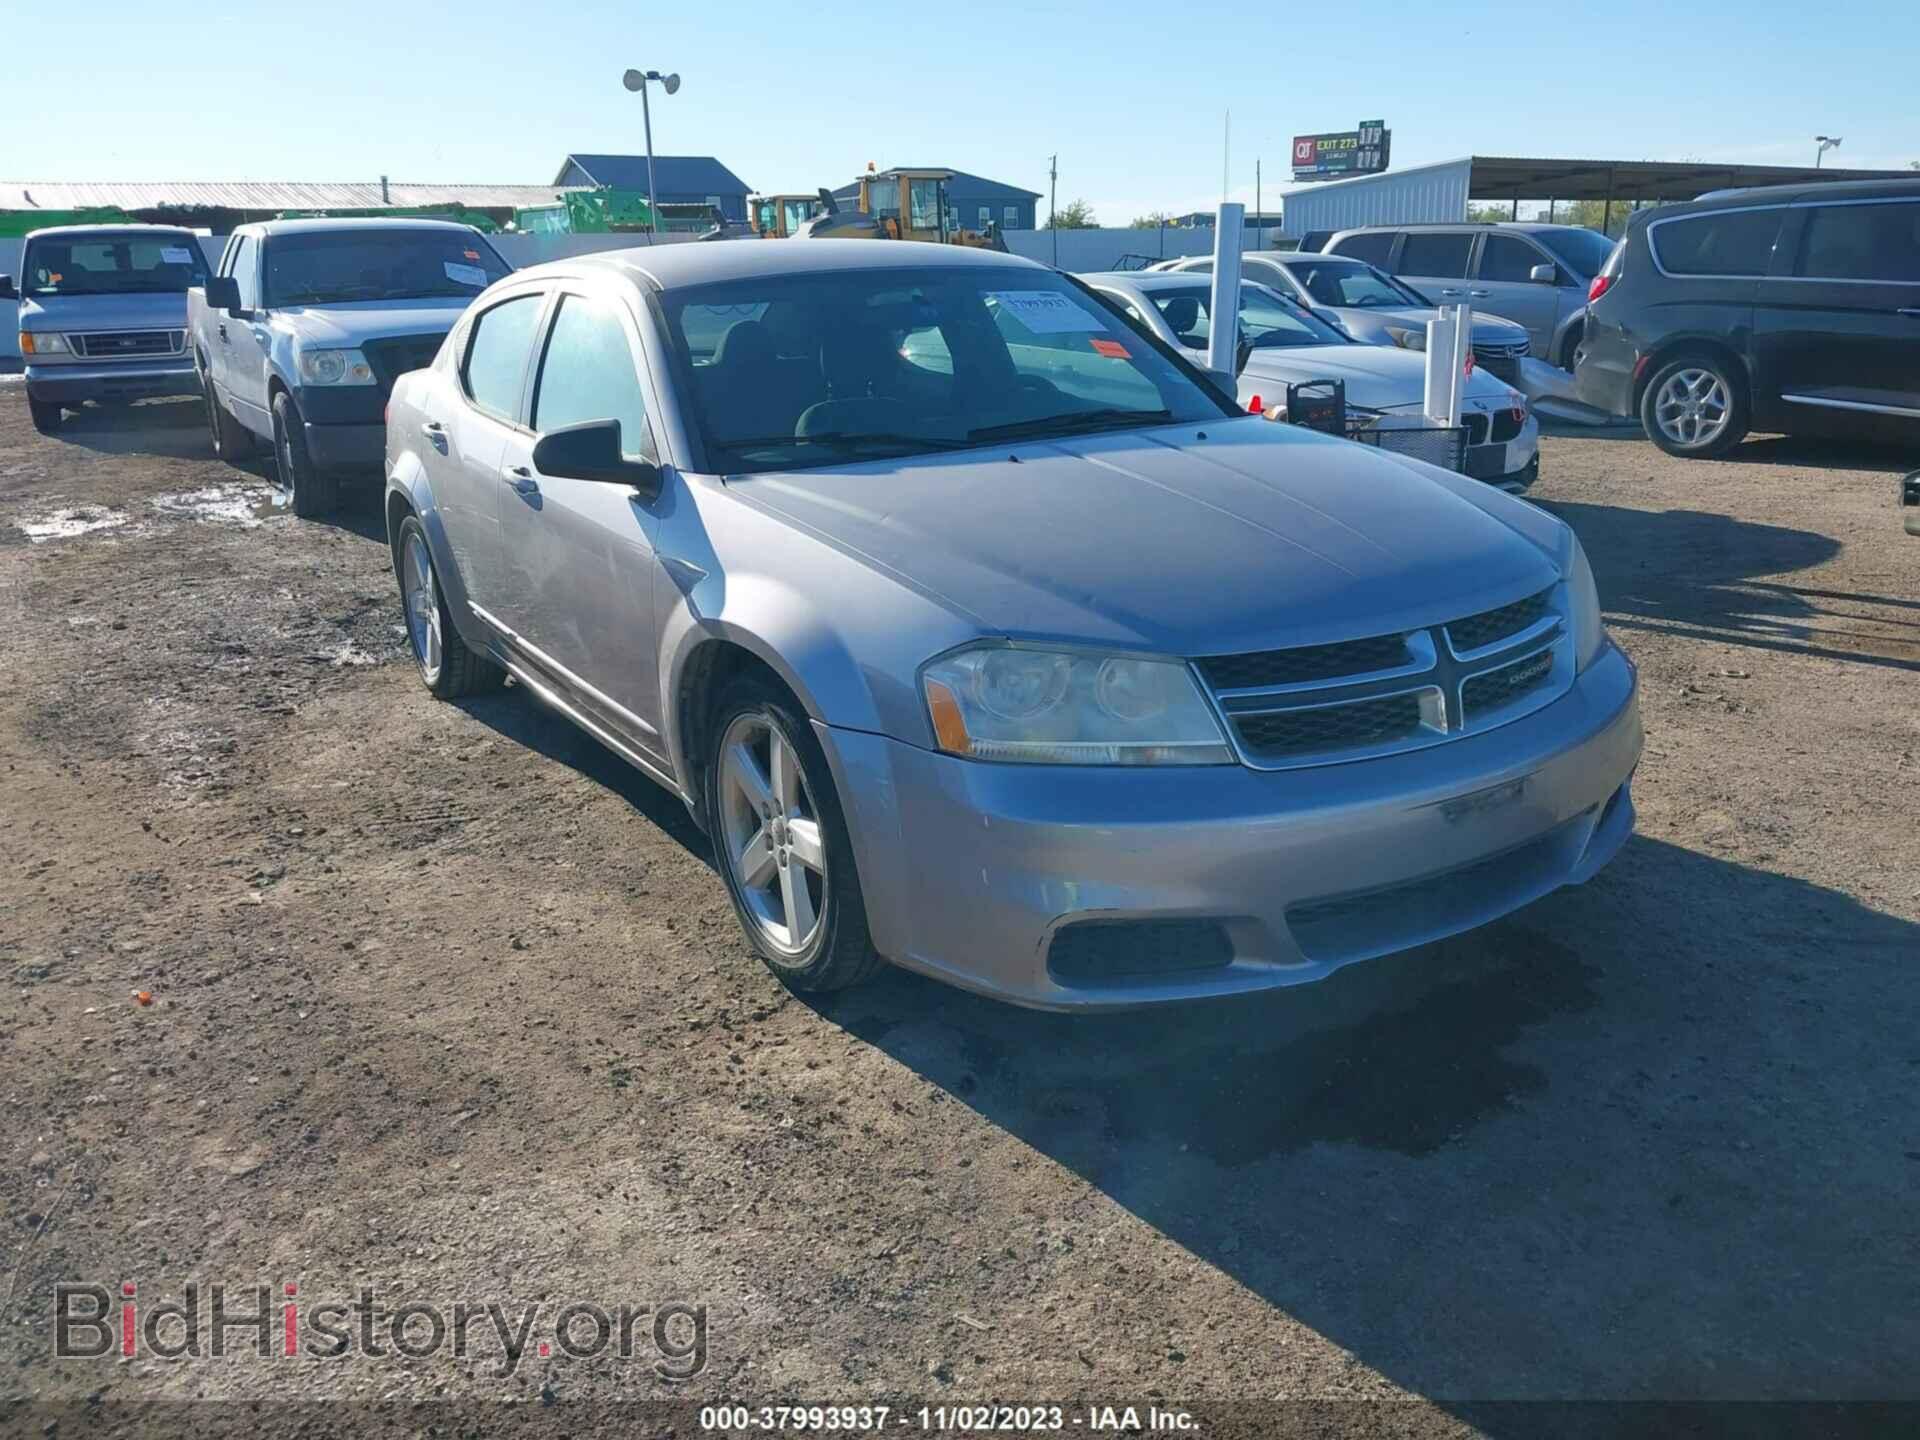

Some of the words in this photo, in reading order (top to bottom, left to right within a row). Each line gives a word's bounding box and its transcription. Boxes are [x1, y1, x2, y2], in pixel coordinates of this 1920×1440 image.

[1296, 142, 1313, 159] QT
[1316, 140, 1338, 150] EXIT
[1340, 138, 1358, 149] 273
